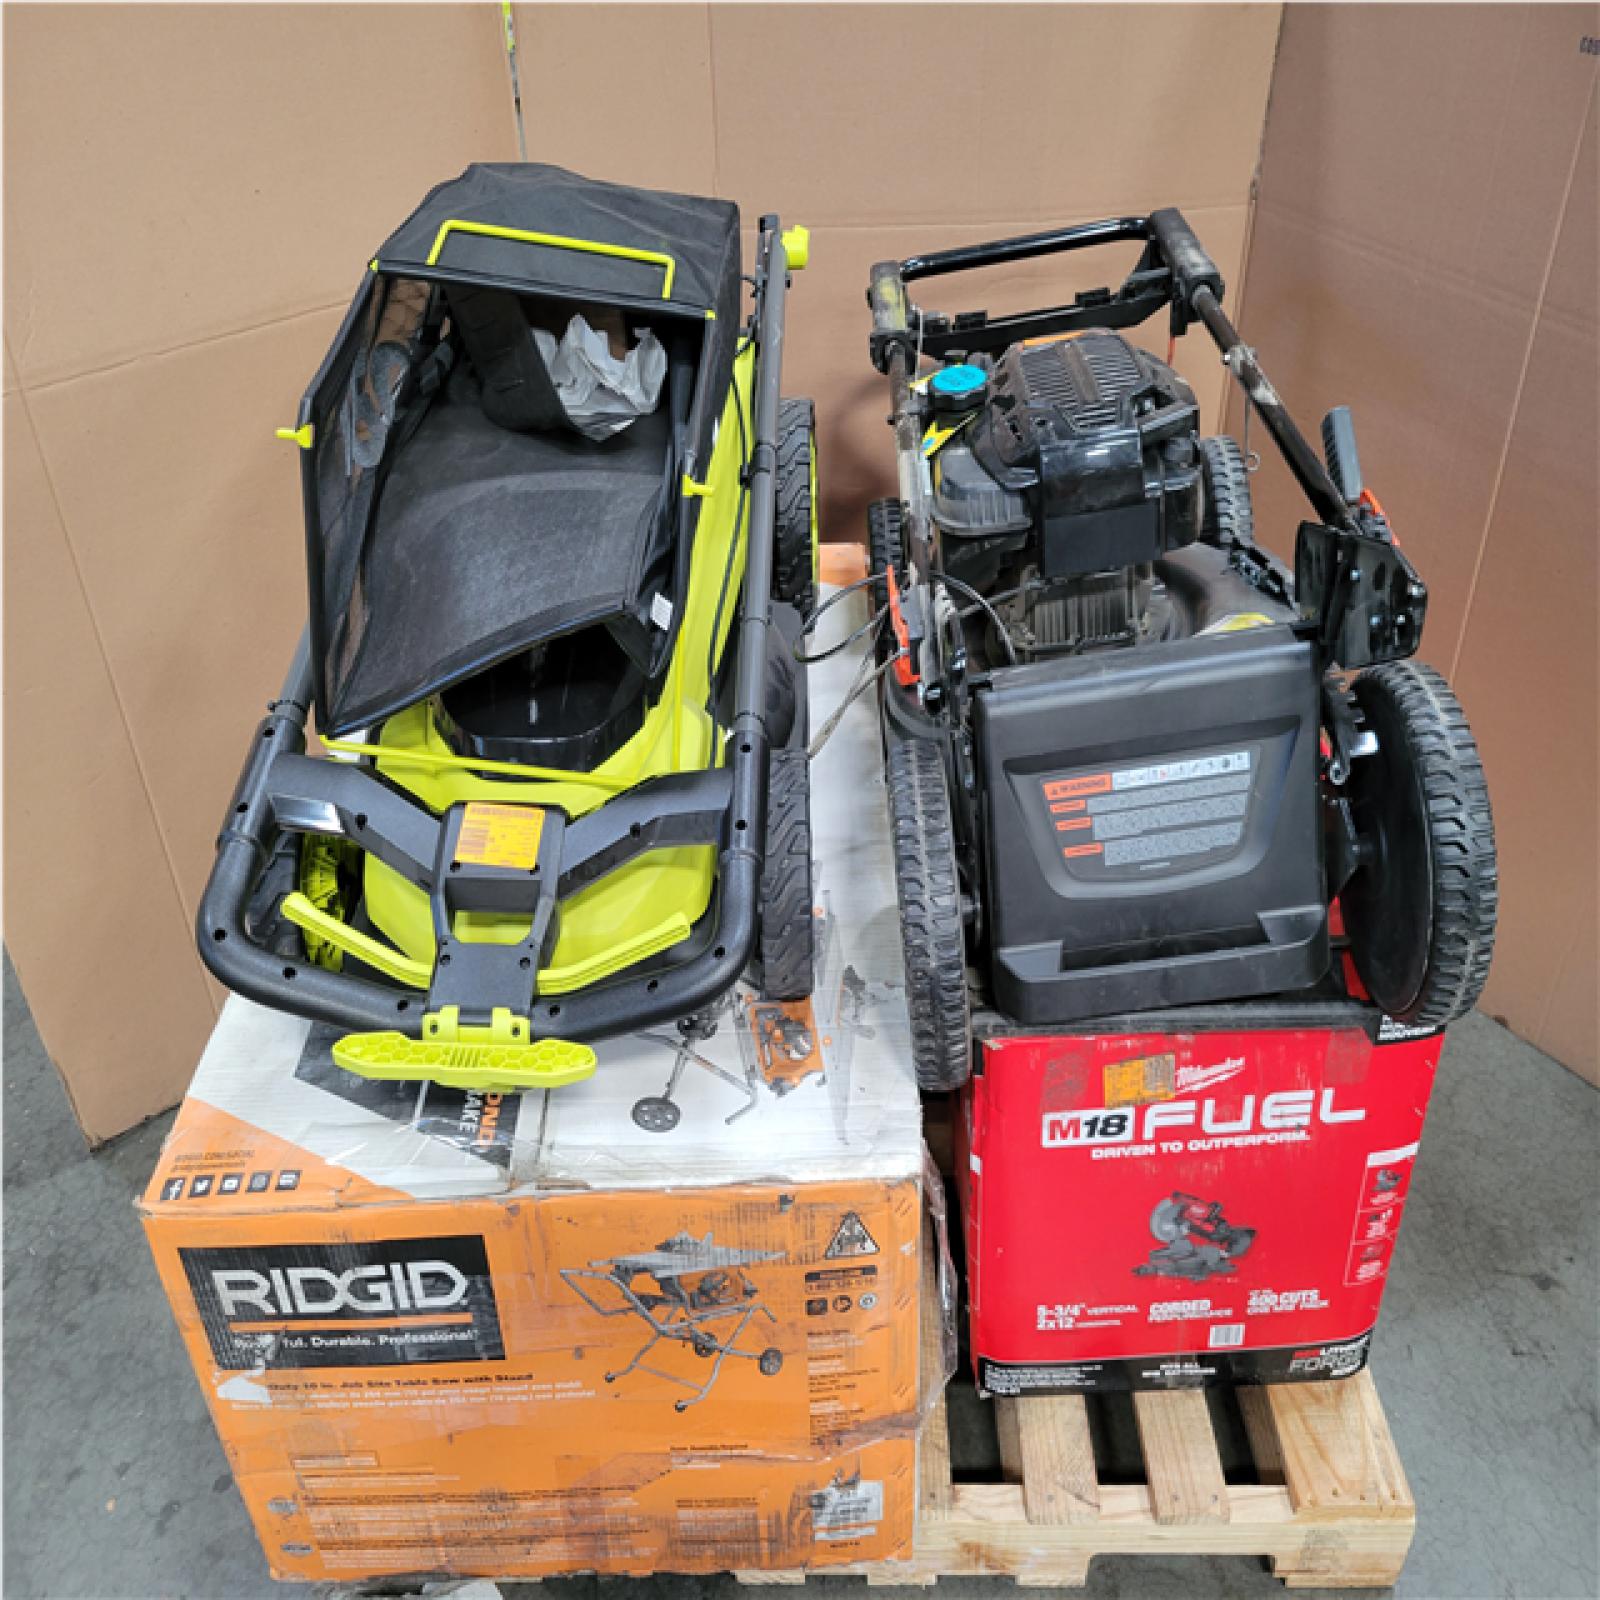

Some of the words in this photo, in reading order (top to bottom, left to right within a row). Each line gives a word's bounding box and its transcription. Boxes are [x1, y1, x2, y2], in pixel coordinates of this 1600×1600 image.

[1049, 1115, 1128, 1142] M18
[1142, 1088, 1366, 1139] FUEL
[1091, 1143, 1155, 1160] DRIVEN
[1160, 1140, 1184, 1154] TO
[210, 1259, 470, 1316] RIDGID
[311, 1335, 377, 1348] Durable.
